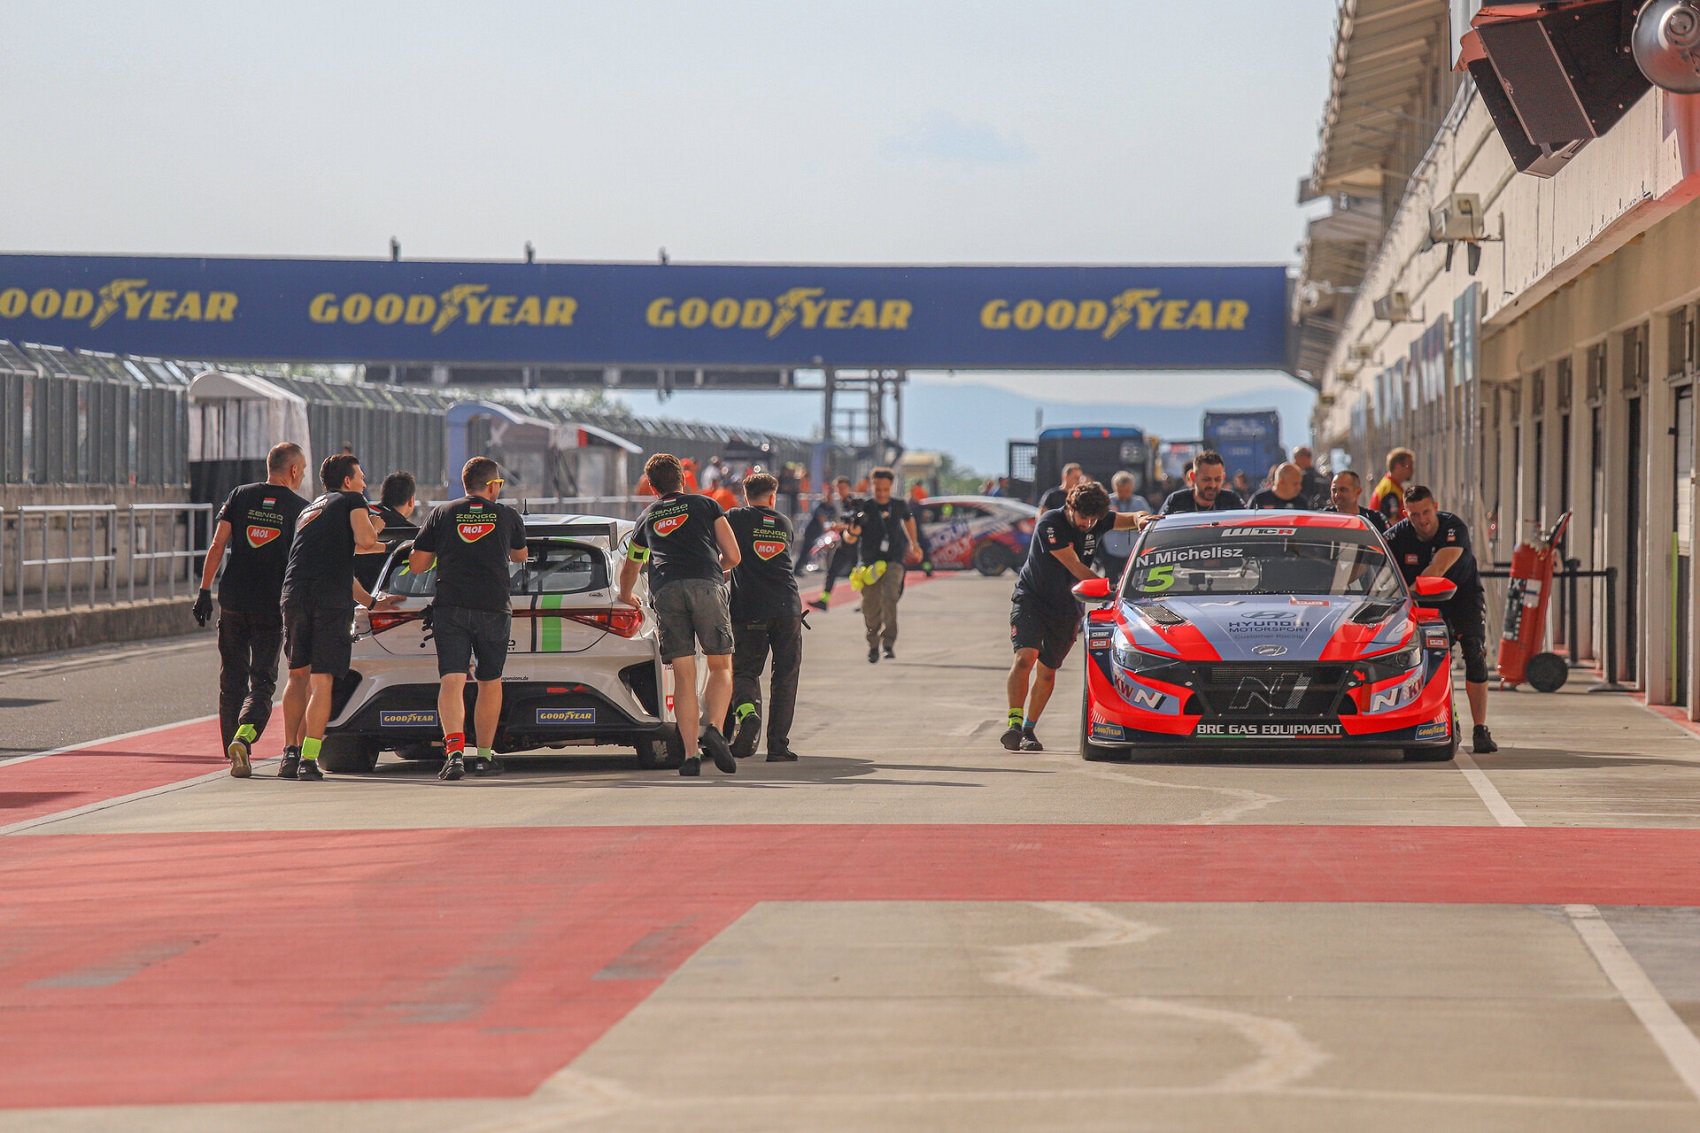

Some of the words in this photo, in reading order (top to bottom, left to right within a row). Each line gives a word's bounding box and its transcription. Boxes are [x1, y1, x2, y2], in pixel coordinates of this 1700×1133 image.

[0, 286, 239, 322] OODYEAR
[309, 291, 578, 327] GOODYEAR
[646, 295, 913, 330] GOODYEAR
[980, 297, 1249, 331] GOODYEAR
[462, 525, 483, 534] MOL
[657, 519, 678, 530] MOL
[250, 528, 269, 538] MOL
[757, 545, 777, 553] MOL
[1136, 547, 1244, 568] N.Michelisz
[1143, 565, 1175, 593] 5
[384, 714, 434, 722] GOODYEAR
[540, 712, 592, 720] GOODYEAR
[1197, 724, 1225, 734] BRC
[1228, 724, 1258, 734] GAS
[1262, 724, 1343, 734] EQUIPMENT
